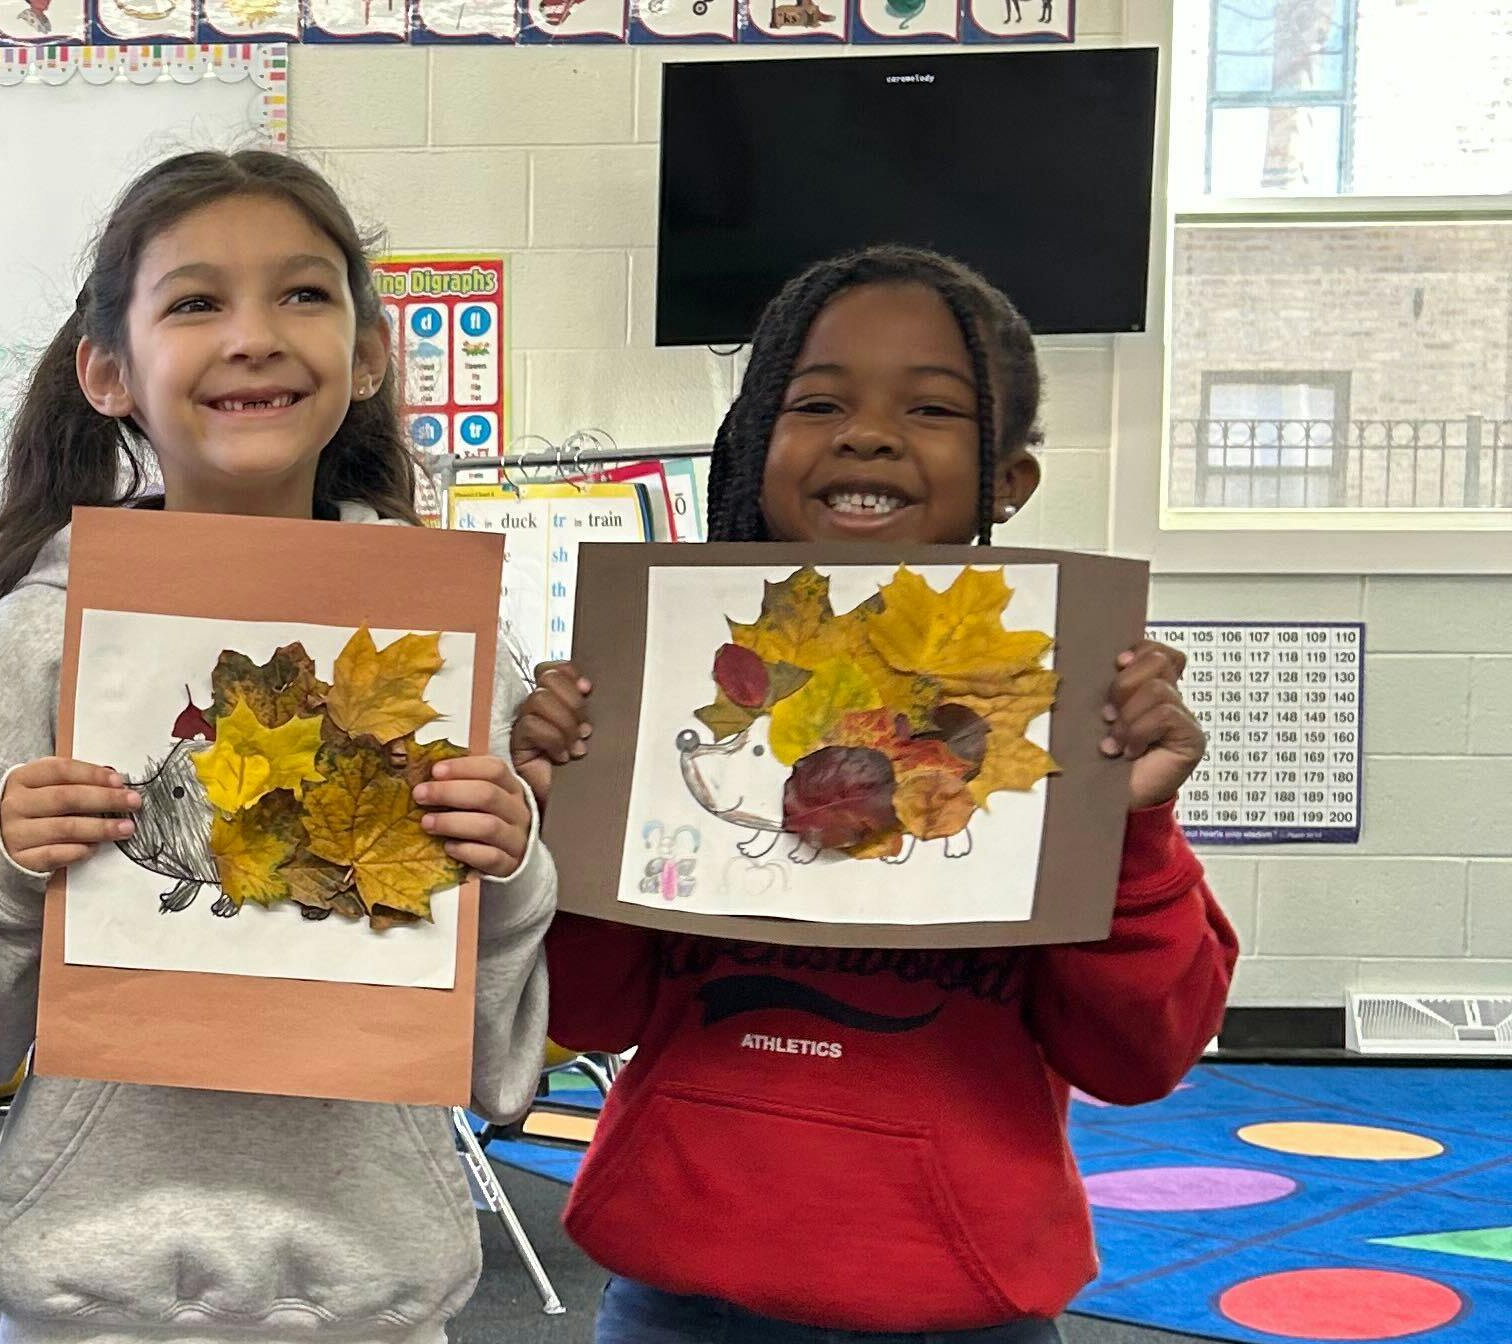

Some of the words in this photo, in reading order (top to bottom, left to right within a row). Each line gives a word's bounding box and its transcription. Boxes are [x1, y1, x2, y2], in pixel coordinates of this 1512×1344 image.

[411, 269, 495, 294] Digraphs
[459, 513, 476, 529] ck
[501, 513, 537, 528] duck
[553, 514, 567, 528] tr
[588, 511, 622, 527] train
[552, 547, 568, 562] sh
[551, 581, 566, 597] th
[551, 616, 565, 632] th
[1164, 632, 1184, 642] 104
[1192, 632, 1213, 642] 105
[1221, 632, 1241, 642] 106
[1249, 632, 1269, 642] 107
[1278, 632, 1298, 642] 108
[1306, 632, 1326, 642] 109
[1337, 632, 1356, 642] 110
[1194, 652, 1213, 663] 115
[1223, 652, 1241, 663] 116
[1251, 652, 1269, 663] 117
[1278, 652, 1298, 663] 118
[1307, 652, 1326, 663] 119
[1335, 652, 1356, 663] 120
[1334, 672, 1355, 683] 130
[1334, 692, 1355, 703] 140
[1333, 712, 1354, 722] 150
[1333, 732, 1354, 742] 160
[1333, 752, 1354, 762] 170
[1333, 772, 1354, 782] 180
[1333, 792, 1354, 802] 190
[1303, 811, 1323, 822] 199
[1329, 811, 1352, 822] 200
[741, 1032, 843, 1059] ATHLETICS
